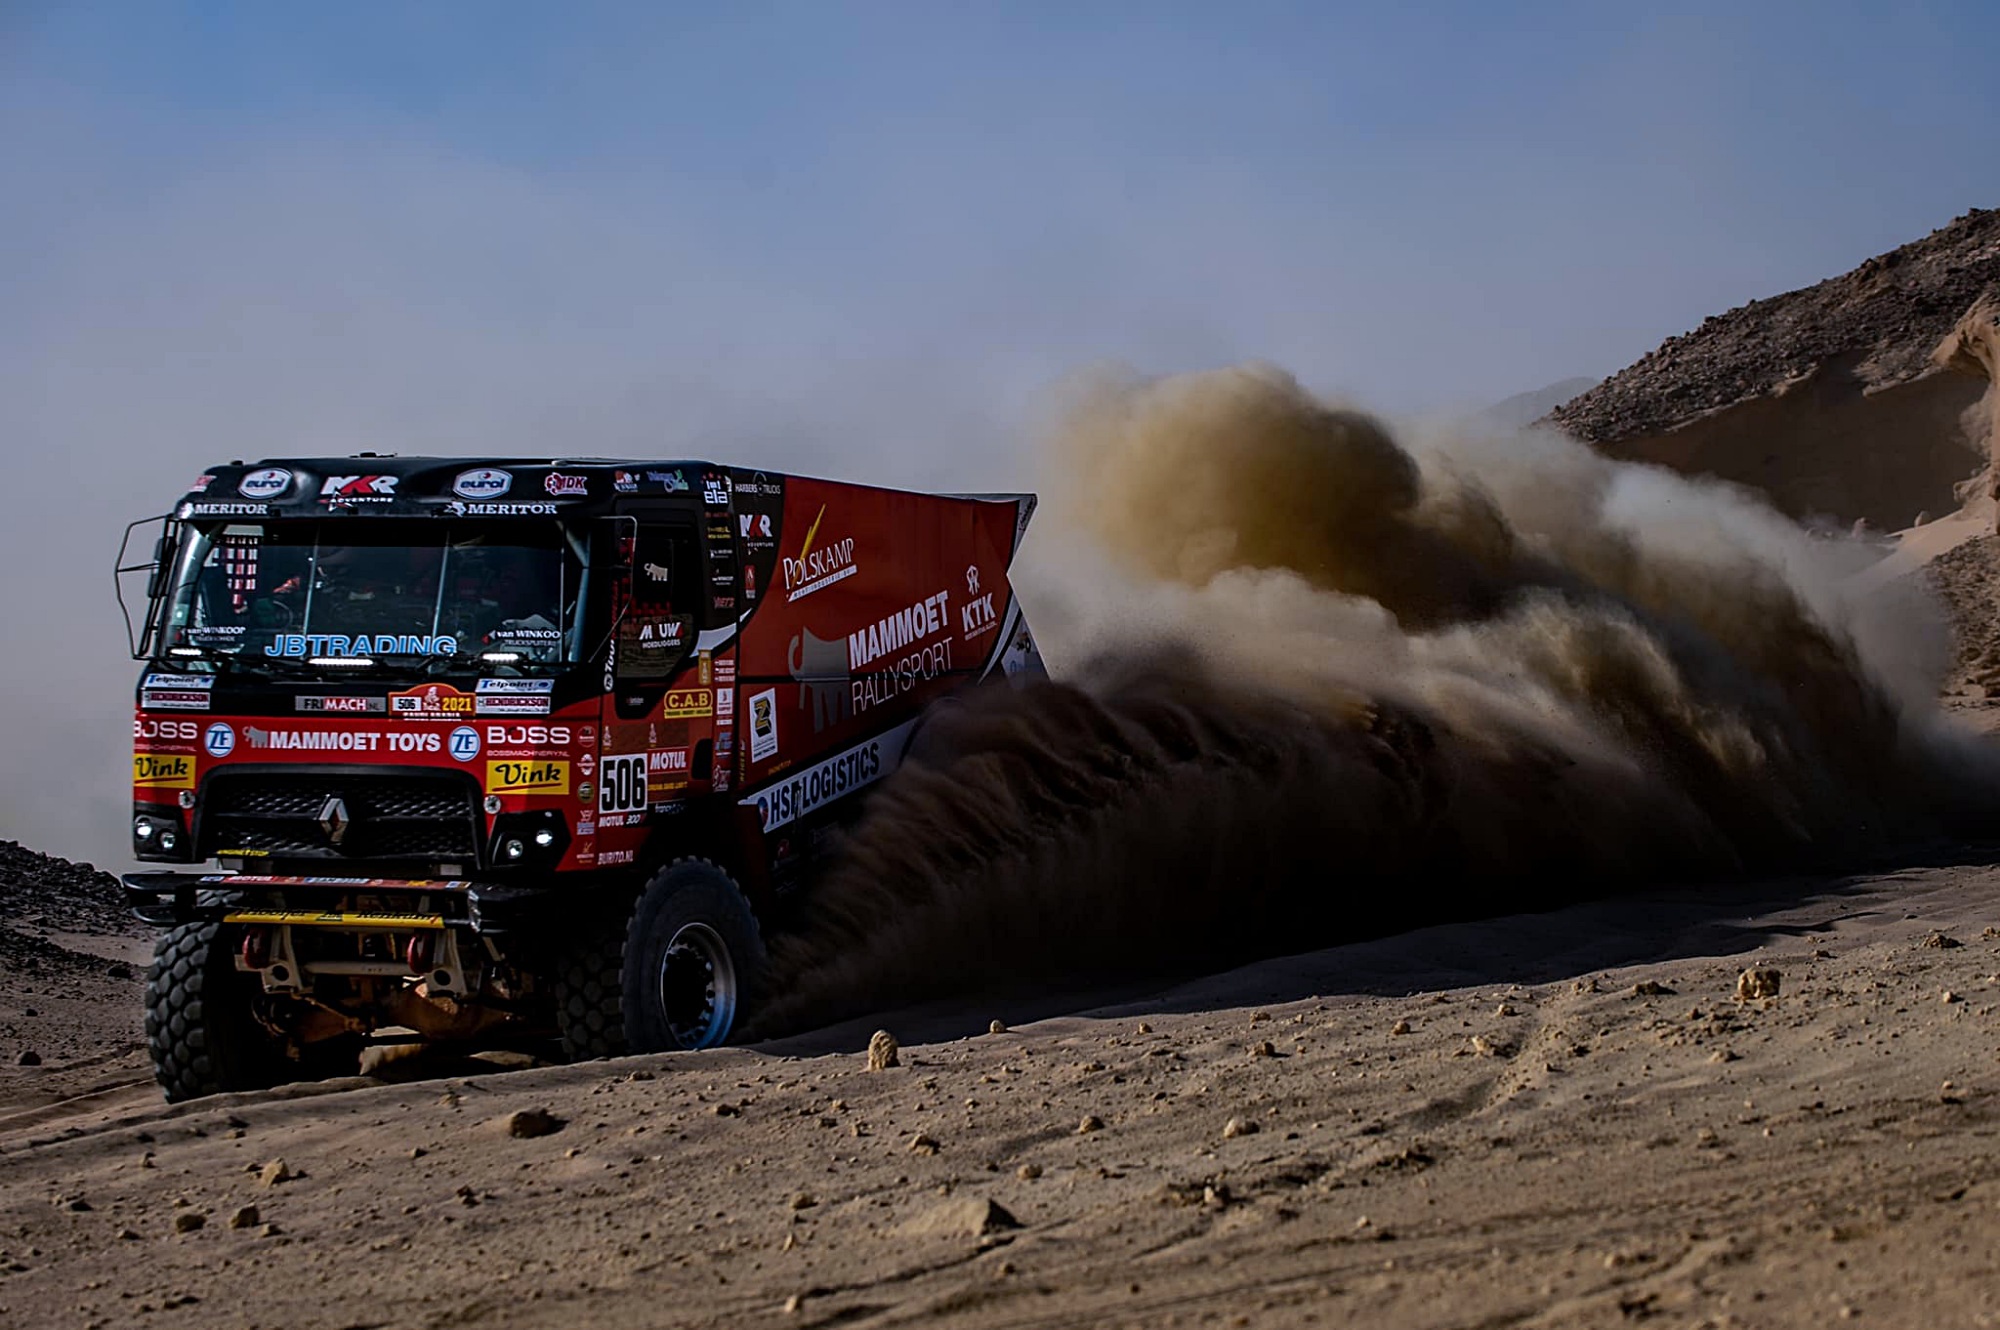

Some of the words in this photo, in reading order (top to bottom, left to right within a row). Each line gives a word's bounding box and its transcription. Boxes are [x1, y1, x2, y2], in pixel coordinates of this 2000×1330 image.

[245, 478, 284, 489] eurol
[460, 478, 504, 488] eurol
[194, 503, 268, 515] MERITOR
[467, 503, 558, 515] MERITOR
[782, 537, 855, 591] POLSKAMP
[961, 592, 996, 634] KTK
[496, 630, 515, 638] van
[848, 589, 949, 671] MAMMOET
[263, 633, 459, 657] JBTRADING
[480, 679, 533, 690] Telpoint
[851, 635, 953, 716] RALLYSPORT
[397, 699, 416, 710] 506
[441, 697, 472, 711] 2021
[668, 693, 709, 708] C.A.B
[207, 730, 231, 750] ZF
[269, 731, 381, 750] MAMMOET
[386, 733, 442, 752] TOYS
[452, 733, 477, 754] ZF
[486, 725, 571, 745] BOSS
[135, 757, 188, 777] Vink
[650, 750, 688, 771] MOTUL
[495, 762, 561, 785] Vink
[801, 742, 880, 809] LOGISTICS
[601, 757, 646, 812] 506
[598, 814, 625, 828] MOTUL
